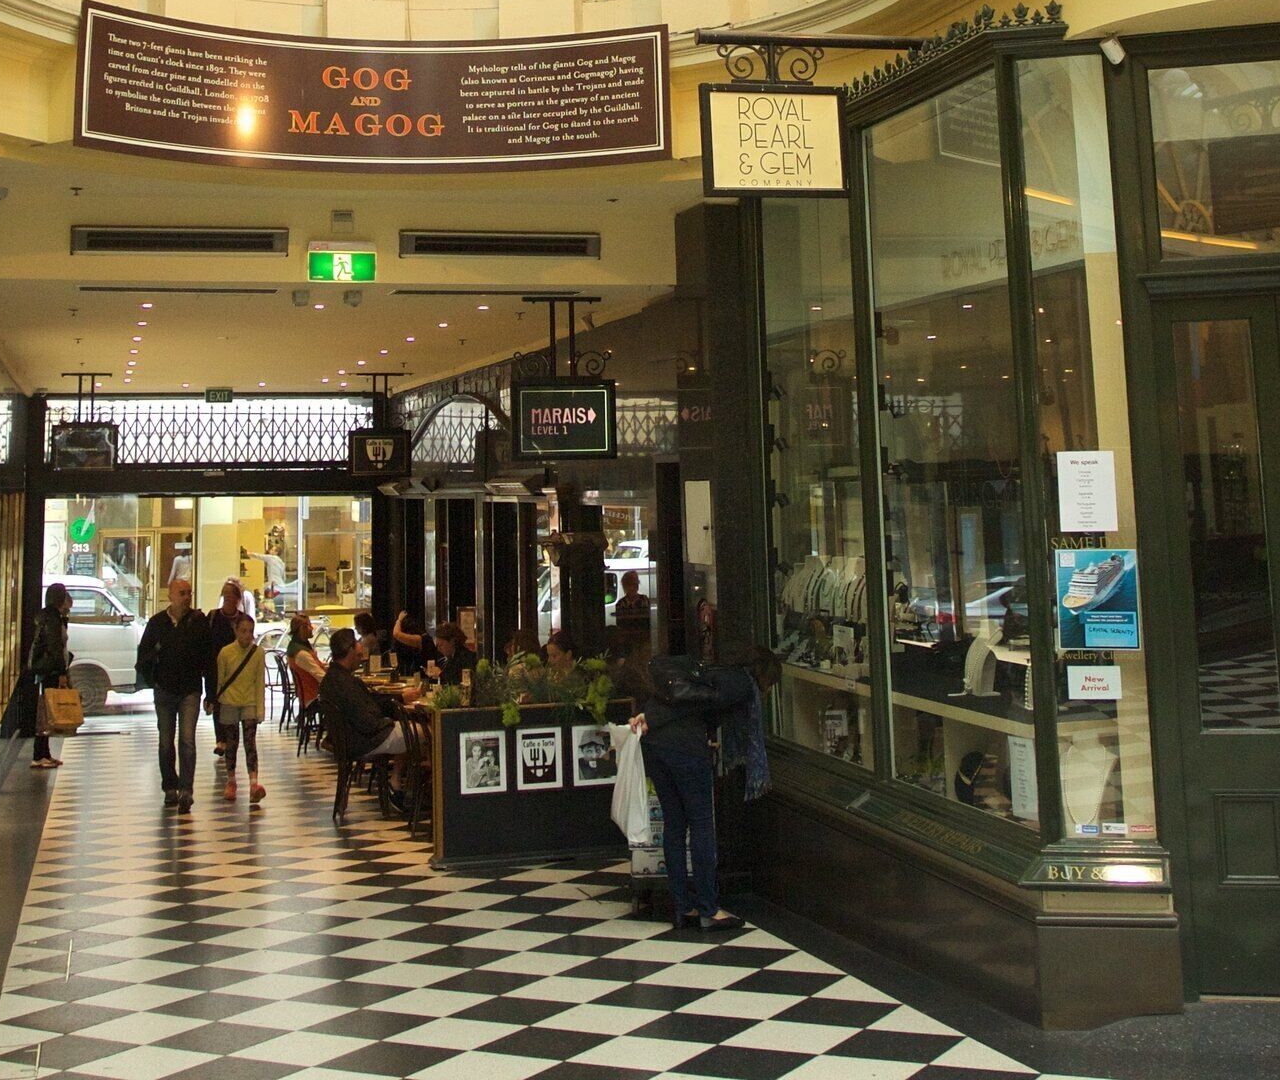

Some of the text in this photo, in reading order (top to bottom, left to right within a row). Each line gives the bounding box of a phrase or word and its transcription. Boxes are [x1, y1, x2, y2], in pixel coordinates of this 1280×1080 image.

[108, 32, 127, 44] These
[129, 39, 141, 47] two
[165, 45, 186, 55] giants
[187, 48, 203, 57] have
[205, 51, 223, 60] been
[224, 55, 253, 67] striking
[255, 57, 267, 66] the
[108, 48, 124, 57] time
[165, 58, 184, 68] clock
[185, 62, 204, 71] since
[206, 64, 227, 74] 1892.
[228, 66, 247, 78] They
[468, 55, 636, 75] Mythology tells of the giants Gog and Magog
[103, 72, 127, 84] figures
[129, 79, 154, 89] erected
[108, 62, 130, 71] carved
[132, 64, 149, 75] from
[151, 69, 168, 78] clear
[170, 73, 186, 81] pine
[188, 75, 202, 83] and
[203, 78, 239, 87] modelled
[252, 82, 265, 90] the
[322, 66, 412, 90] GOG
[461, 77, 479, 86] (also
[519, 74, 555, 83] Corineus
[557, 72, 571, 80] and
[573, 67, 617, 80] Gogmagog)
[619, 67, 644, 75] having
[460, 89, 479, 97] been
[481, 88, 515, 98] captured
[528, 86, 550, 95] battle
[551, 85, 560, 94] by
[562, 84, 575, 92] the
[575, 82, 606, 92] Trojans
[608, 79, 622, 88] and
[624, 77, 645, 86] made
[114, 90, 148, 100] symbolise
[150, 94, 161, 103] the
[162, 98, 190, 107] conflict
[192, 100, 222, 110] between
[350, 96, 381, 107] AND
[507, 100, 535, 110] porters
[560, 97, 588, 107] gateway
[590, 94, 599, 102] of
[611, 91, 640, 100] ancient
[738, 96, 812, 122] ROYAL
[125, 103, 152, 114] Britons
[181, 111, 208, 123] Trojan
[462, 113, 487, 123] palace
[522, 111, 541, 119] later
[542, 108, 577, 119] occupied
[579, 107, 588, 117] by
[590, 106, 602, 114] the
[288, 109, 445, 137] MAGOG
[484, 124, 526, 133] traditional
[528, 123, 540, 131] for
[542, 122, 559, 131] Gog
[602, 117, 615, 125] the
[617, 114, 639, 124] north
[507, 136, 523, 144] and
[524, 135, 550, 145] Magog
[562, 133, 575, 141] the
[739, 123, 814, 149] PEARL
[739, 151, 812, 175] & GEM
[739, 179, 813, 187] COMPANY
[210, 391, 228, 401] EXIT
[530, 407, 586, 424] MARAIS
[531, 425, 559, 435] LEVEL
[72, 543, 90, 552] 313
[1081, 684, 1109, 692] Arrival
[1084, 675, 1104, 683] New
